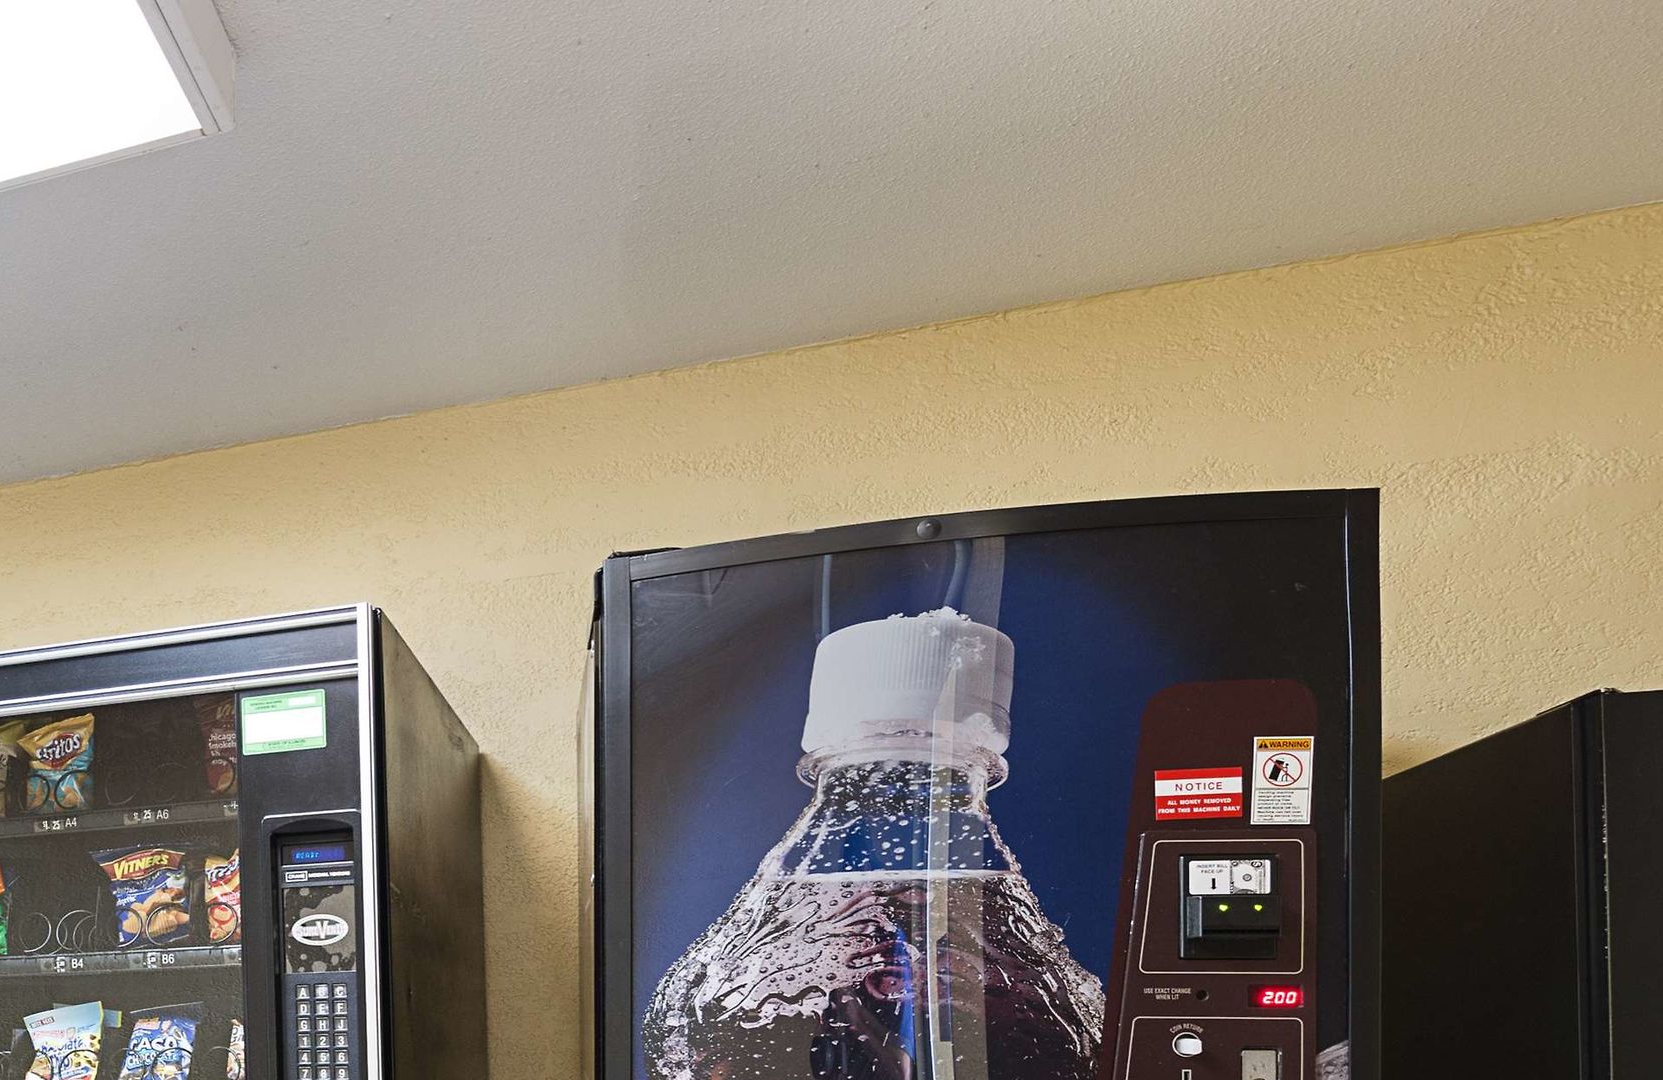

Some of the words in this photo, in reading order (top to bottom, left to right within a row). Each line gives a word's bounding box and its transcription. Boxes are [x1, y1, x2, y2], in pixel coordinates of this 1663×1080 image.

[1175, 782, 1223, 791] NOTICE
[156, 809, 169, 820] A6
[65, 818, 77, 827] A4
[300, 988, 306, 996] A
[337, 987, 343, 995] C
[301, 1004, 307, 1012] D
[319, 1004, 326, 1012] E
[337, 1003, 344, 1011] F
[301, 1021, 307, 1029] G
[319, 1021, 326, 1029] H
[338, 1020, 344, 1028] J
[303, 1037, 307, 1045] 1
[320, 1037, 326, 1045] 2
[338, 1036, 344, 1045] 3
[301, 1053, 307, 1061] 4
[320, 1053, 326, 1061] 5
[338, 1053, 345, 1061] 6
[303, 1070, 309, 1078] 7
[339, 1069, 345, 1077] 9
